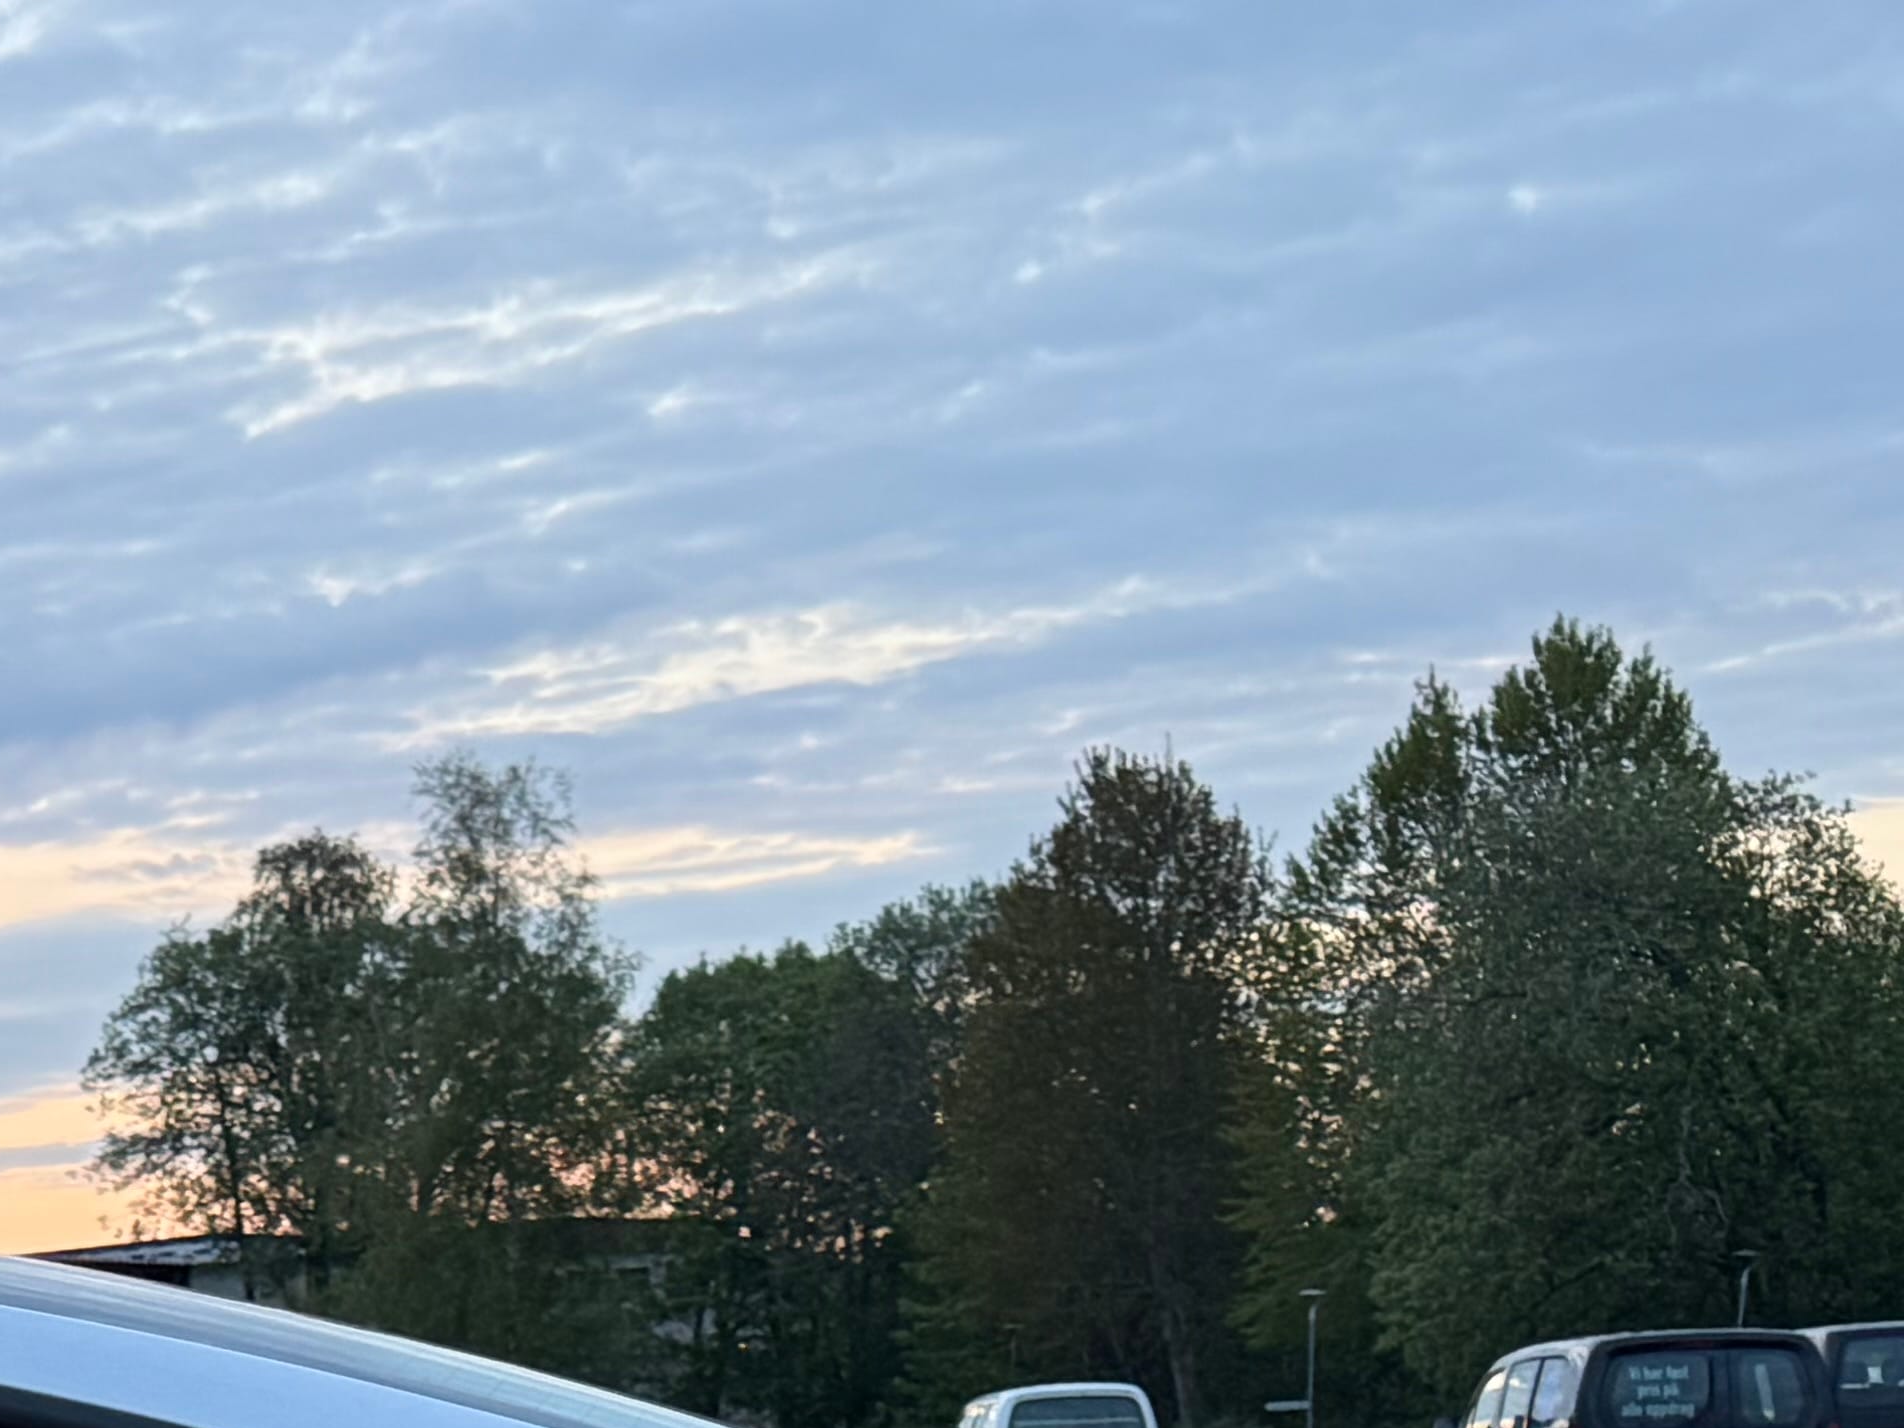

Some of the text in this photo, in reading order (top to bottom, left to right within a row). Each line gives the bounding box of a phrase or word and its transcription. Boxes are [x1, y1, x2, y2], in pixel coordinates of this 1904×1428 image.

[1629, 1366, 1641, 1380] Vi
[1643, 1366, 1663, 1380] har
[1637, 1382, 1679, 1399] pris på
